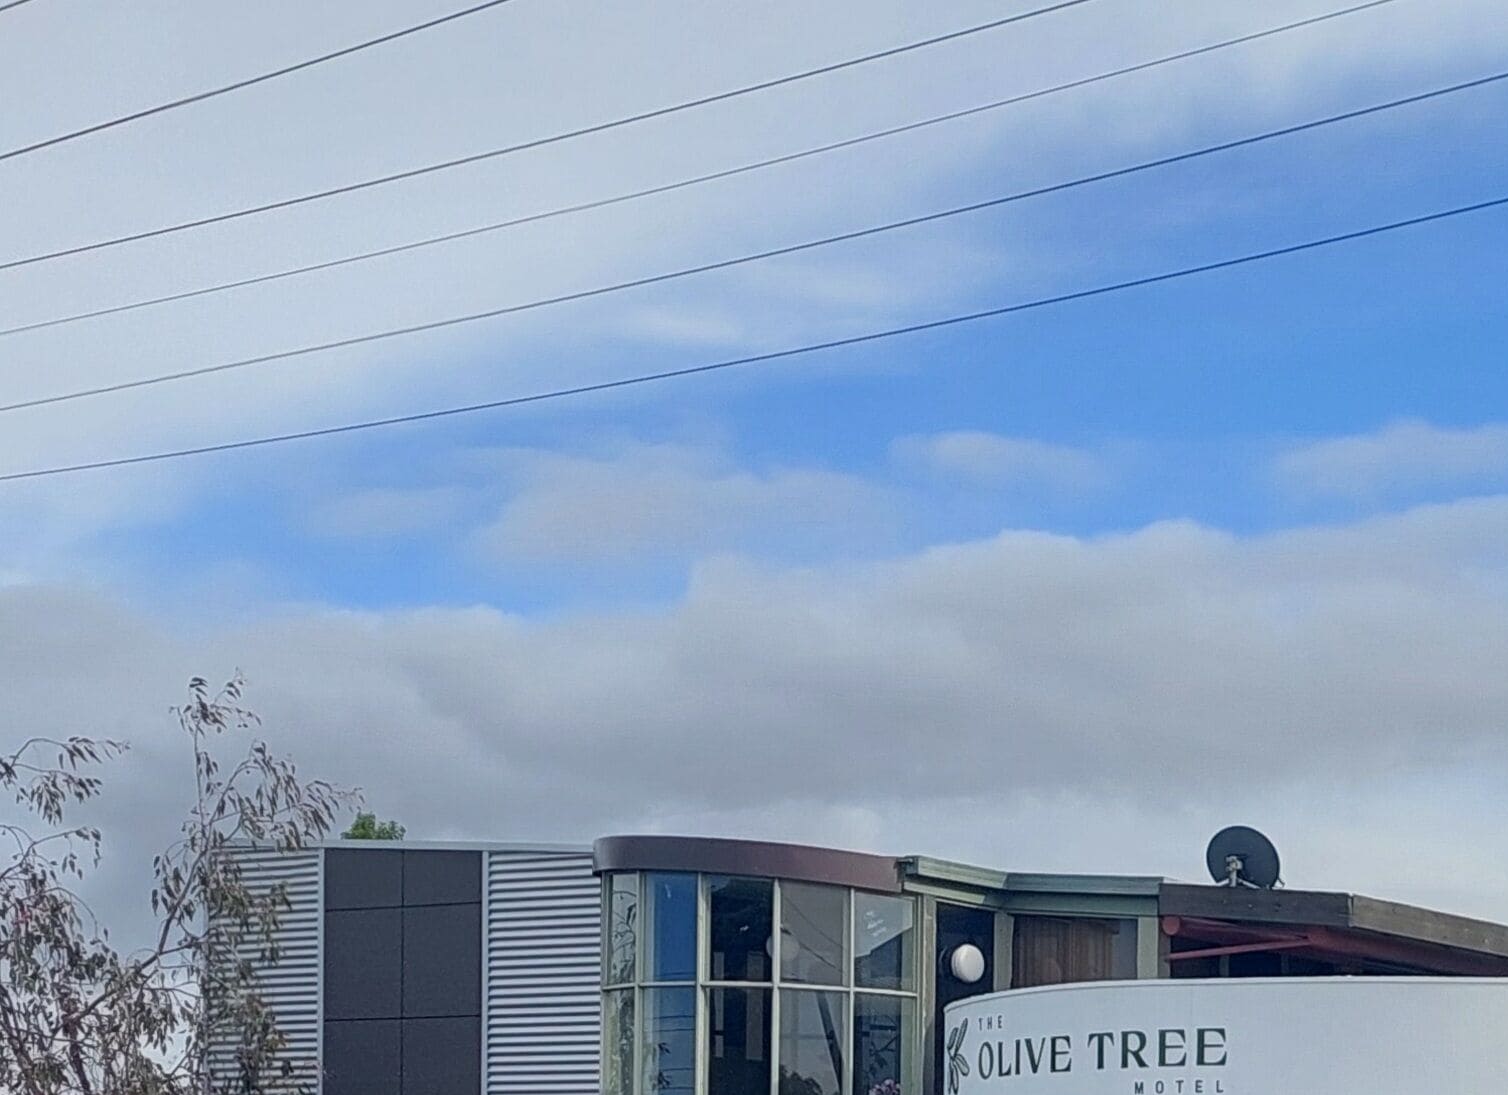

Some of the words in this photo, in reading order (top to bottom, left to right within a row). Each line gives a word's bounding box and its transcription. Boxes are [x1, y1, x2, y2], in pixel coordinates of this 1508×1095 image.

[978, 1014, 1003, 1031] THE
[978, 1035, 1072, 1080] OLIVE
[1087, 1027, 1228, 1070] TREE
[1134, 1079, 1224, 1095] MOTEL
